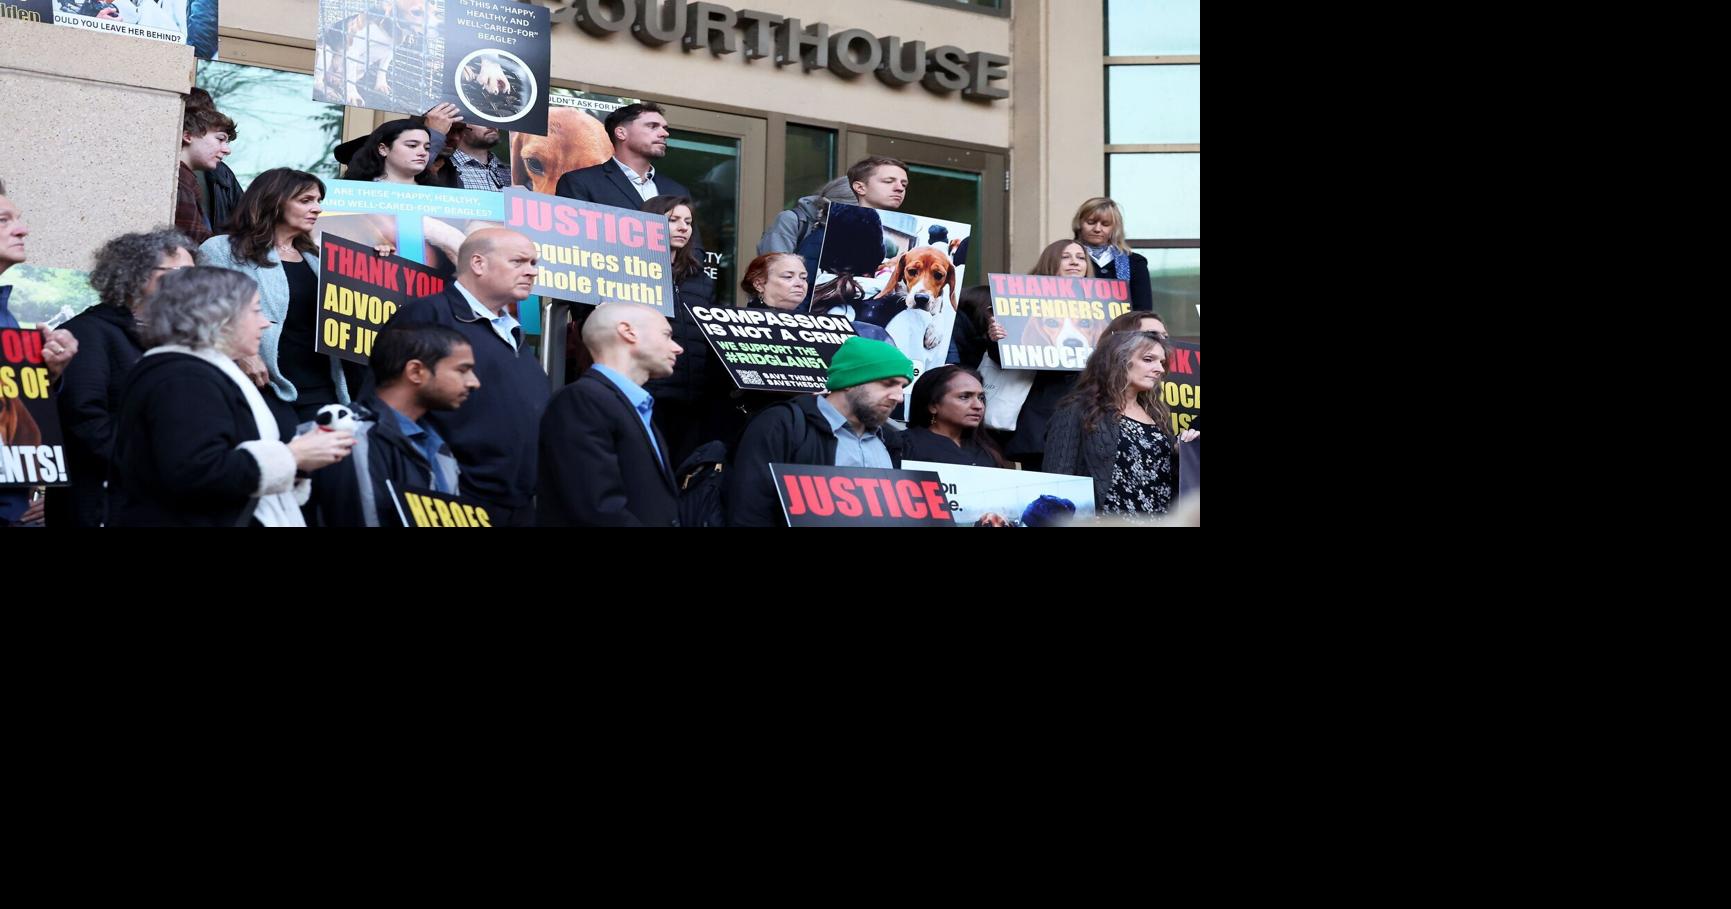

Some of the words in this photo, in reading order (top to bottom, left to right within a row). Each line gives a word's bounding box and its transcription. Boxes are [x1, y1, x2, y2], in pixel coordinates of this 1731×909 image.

[466, 10, 509, 24] HEALTHY,
[510, 18, 530, 27] AND
[471, 0, 490, 10] THIS
[492, 3, 499, 11] A
[500, 6, 536, 19] “HAPPY,
[81, 19, 99, 30] YOU
[100, 23, 127, 34] LEAVE
[128, 27, 145, 36] HER
[146, 30, 181, 43] BEHIND?
[457, 18, 539, 38] WELL-CARED-FOR”
[478, 33, 517, 45] BEAGLE?
[550, 0, 1010, 99] OURTHOUSE
[577, 100, 593, 108] ASK
[333, 187, 353, 196] ARE
[358, 189, 387, 199] THESE
[435, 194, 481, 206] HEALTHY,
[444, 206, 493, 217] BEAGLES?
[509, 196, 667, 252] JUSTICE
[324, 241, 399, 291] THANK
[403, 267, 444, 298] YOU
[624, 254, 663, 280] the
[704, 251, 722, 264] TY
[534, 266, 592, 293] hole
[597, 277, 663, 306] truth!
[991, 275, 1076, 298] THANK
[1080, 277, 1128, 301] YOU
[692, 306, 855, 333] COMPASSION
[995, 297, 1105, 321] DEFENDERS
[323, 318, 351, 350] OF
[702, 322, 727, 337] IS
[728, 325, 773, 340] NOT
[780, 328, 798, 342] A
[2, 329, 43, 364] OU
[716, 340, 738, 351] WE
[738, 342, 793, 356] SUPPORT
[795, 346, 820, 357] THE
[1002, 344, 1094, 369] INNOCE
[725, 352, 829, 369] #RIDGLAN51
[0, 365, 19, 399] S
[20, 366, 50, 399] OF
[762, 372, 787, 380] SAVE
[788, 374, 815, 382] THEM
[783, 474, 950, 520] JUSTICE
[404, 492, 493, 527] HEROES
